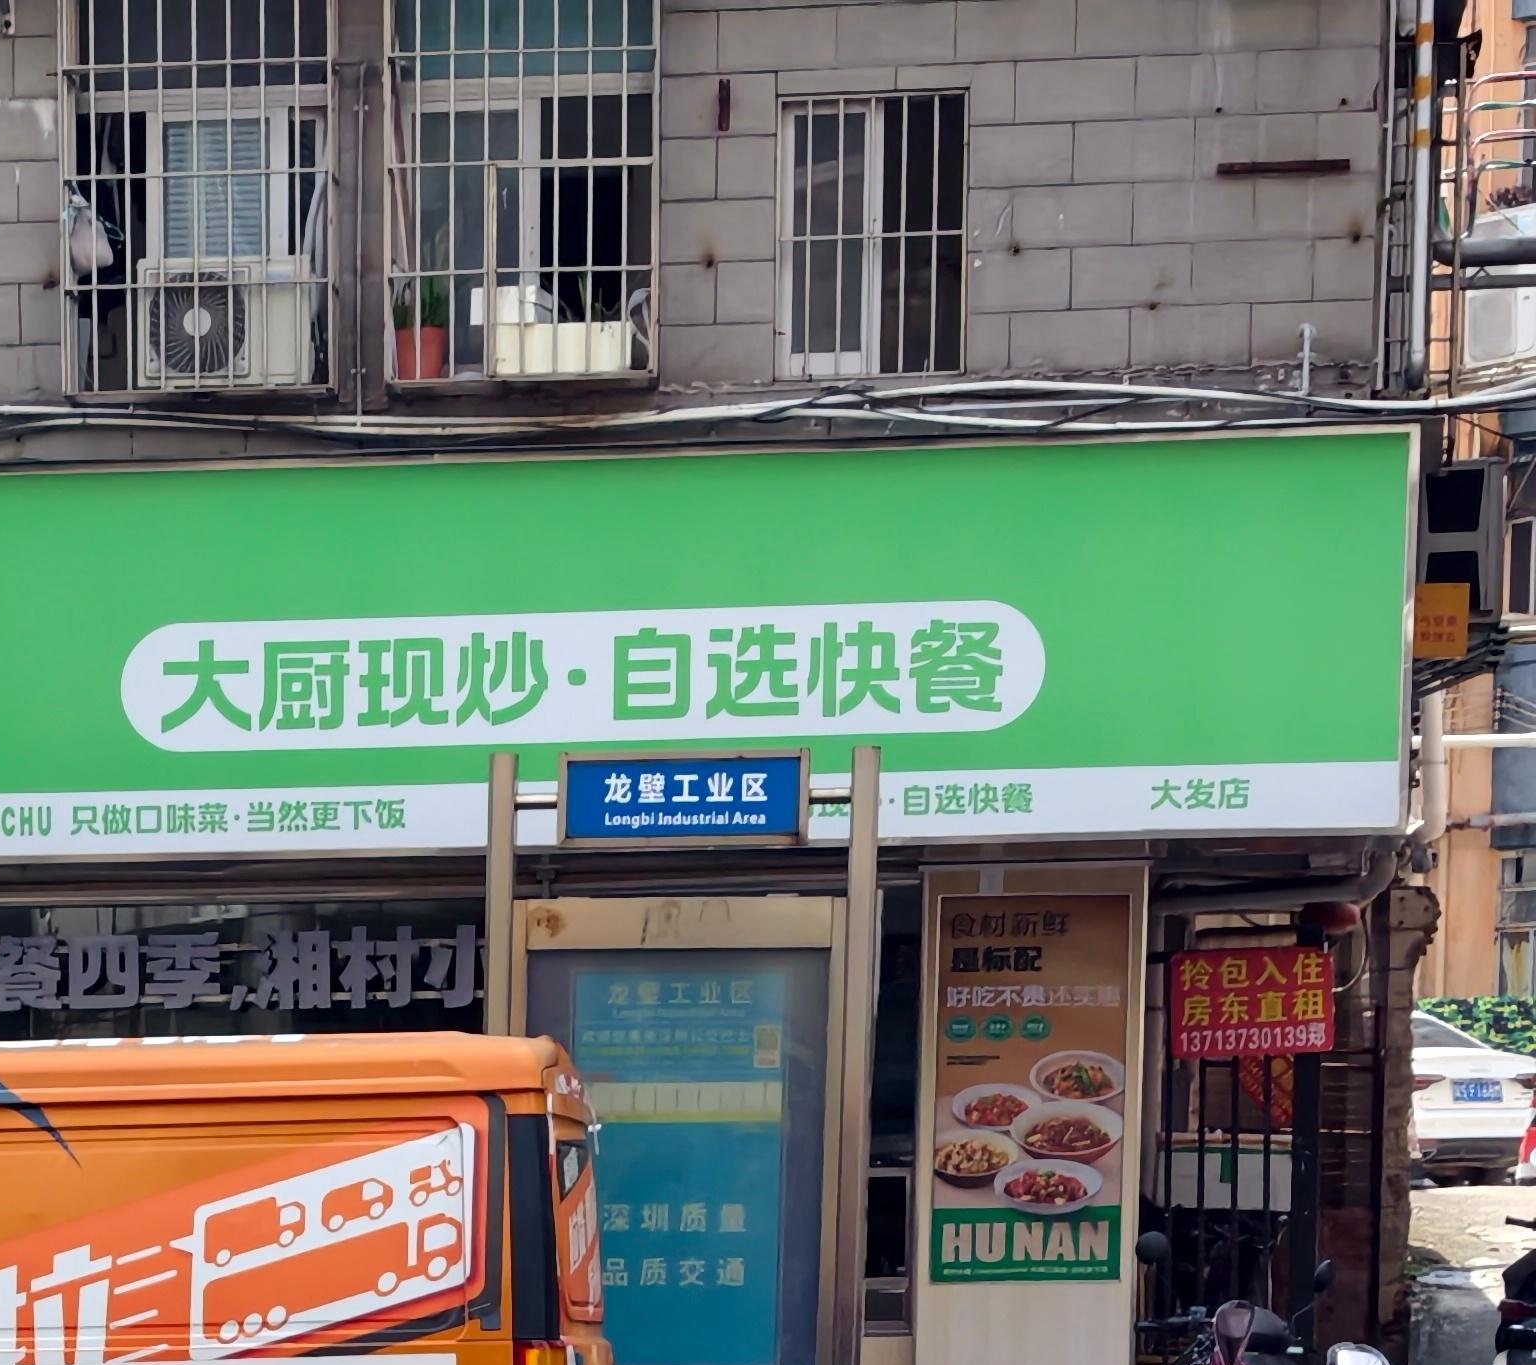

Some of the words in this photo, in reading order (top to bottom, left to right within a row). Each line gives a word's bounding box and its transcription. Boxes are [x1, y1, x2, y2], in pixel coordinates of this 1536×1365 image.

[160, 618, 1005, 733] 大厨现炒·自选快餐
[604, 772, 768, 803] 龙壁工业区
[1150, 778, 1251, 810] 大发店
[70, 798, 407, 835] 只做口味菜·当然更下饭
[604, 812, 654, 829] Longbi
[658, 811, 729, 825] Industrial
[732, 811, 766, 825] Area
[1180, 952, 1325, 991] 拎包入住
[1181, 988, 1325, 1026] 房东直租
[941, 1220, 1110, 1264] HUNAN
[602, 1256, 745, 1287] 品质交通
